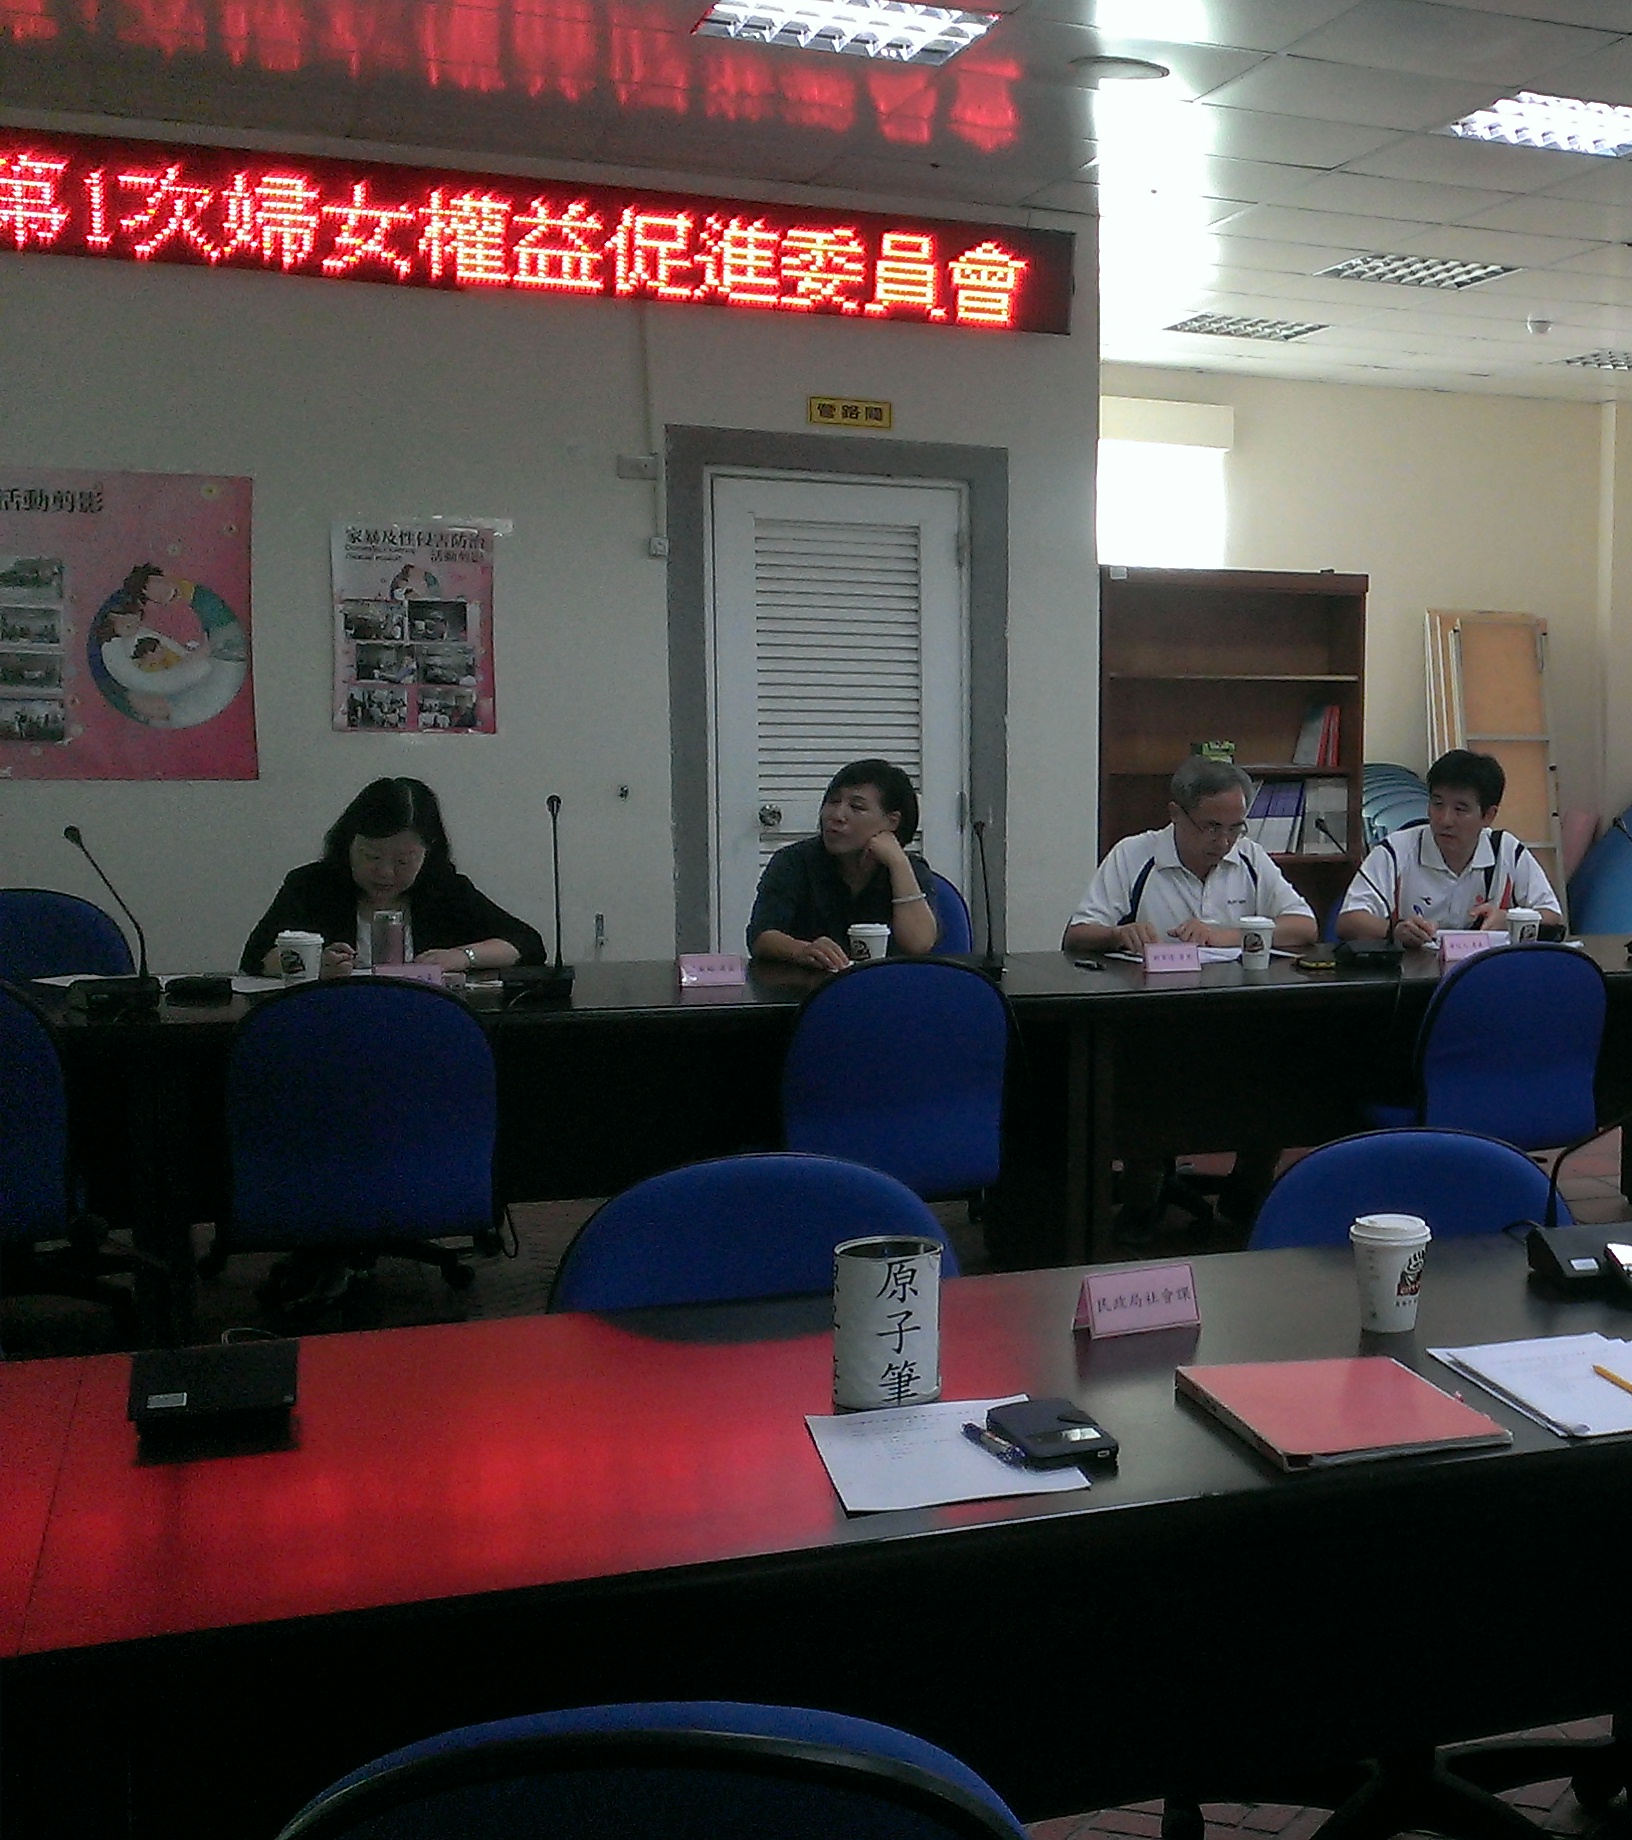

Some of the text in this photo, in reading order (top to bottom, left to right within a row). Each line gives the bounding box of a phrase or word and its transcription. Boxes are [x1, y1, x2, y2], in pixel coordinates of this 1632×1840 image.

[875, 1257, 922, 1405] 原子筆
[1096, 1286, 1191, 1313] 民政局社會課
